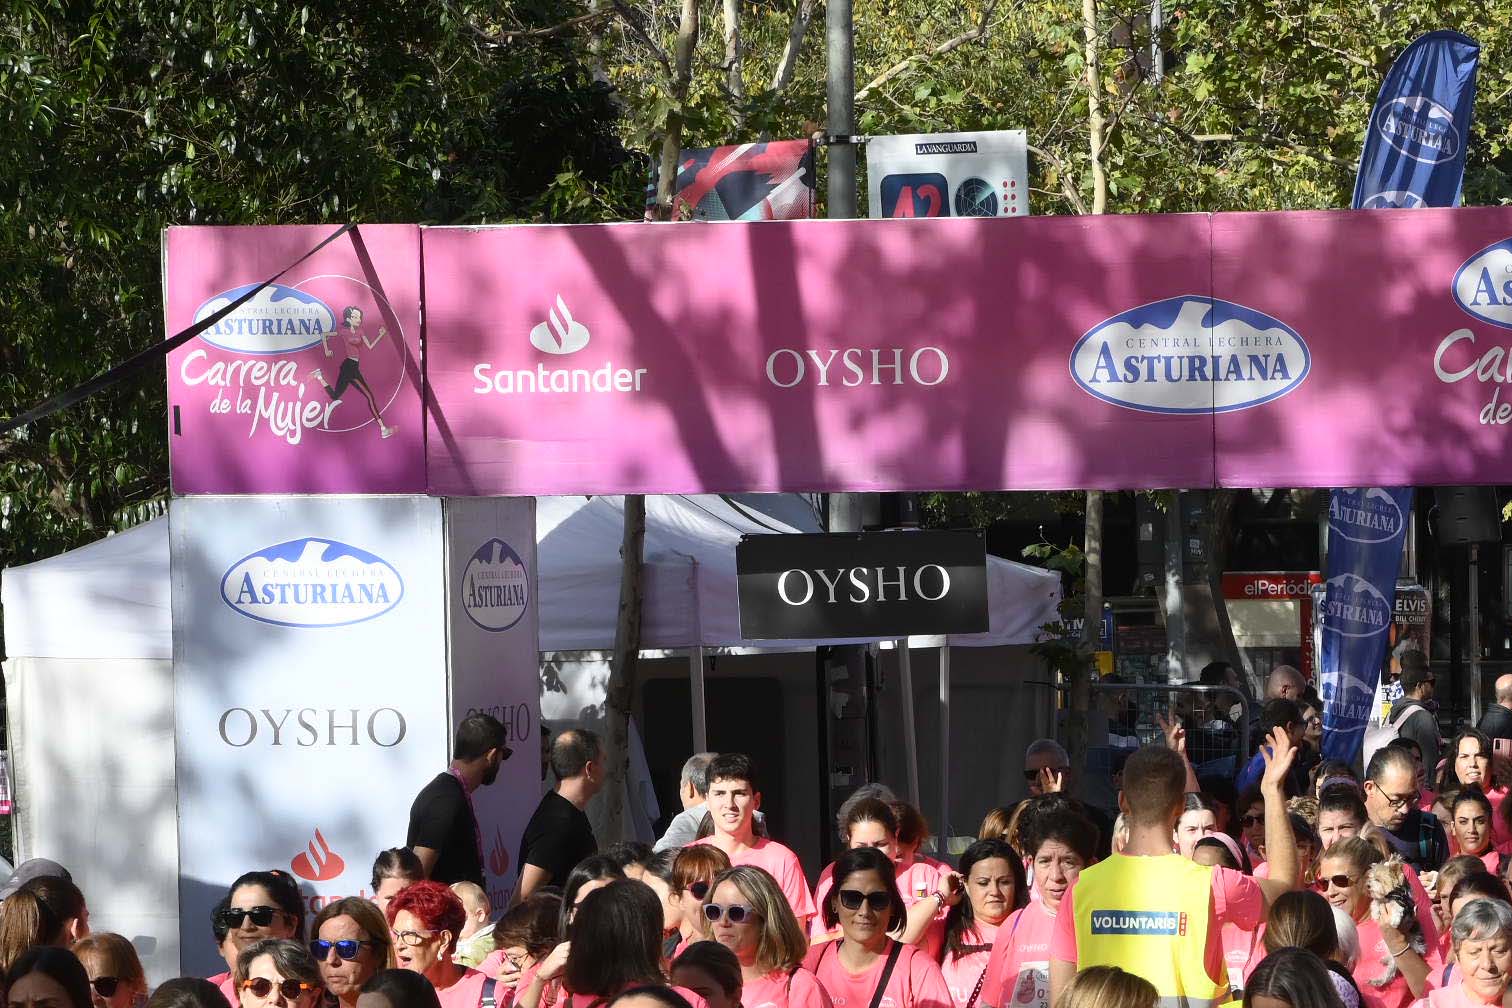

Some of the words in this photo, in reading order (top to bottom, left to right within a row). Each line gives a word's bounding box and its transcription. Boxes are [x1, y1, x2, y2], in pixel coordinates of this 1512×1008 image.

[1126, 337, 1200, 349] CENTRAL
[1208, 335, 1283, 348] LECHERA
[180, 350, 298, 388] Carrera
[473, 362, 648, 394] Santander
[766, 346, 950, 388] OYSHO
[1088, 341, 1292, 384] ASTURIANA
[210, 390, 232, 414] de
[236, 388, 252, 414] la
[249, 376, 343, 445] Mujer
[234, 571, 390, 605] ASTURIANA
[467, 573, 525, 610] ASTURIANA
[776, 564, 951, 606] OYSHO
[1395, 600, 1426, 612] ELVIS
[218, 707, 408, 748] OYSHO
[1093, 916, 1176, 930] VOLUNTARIS
